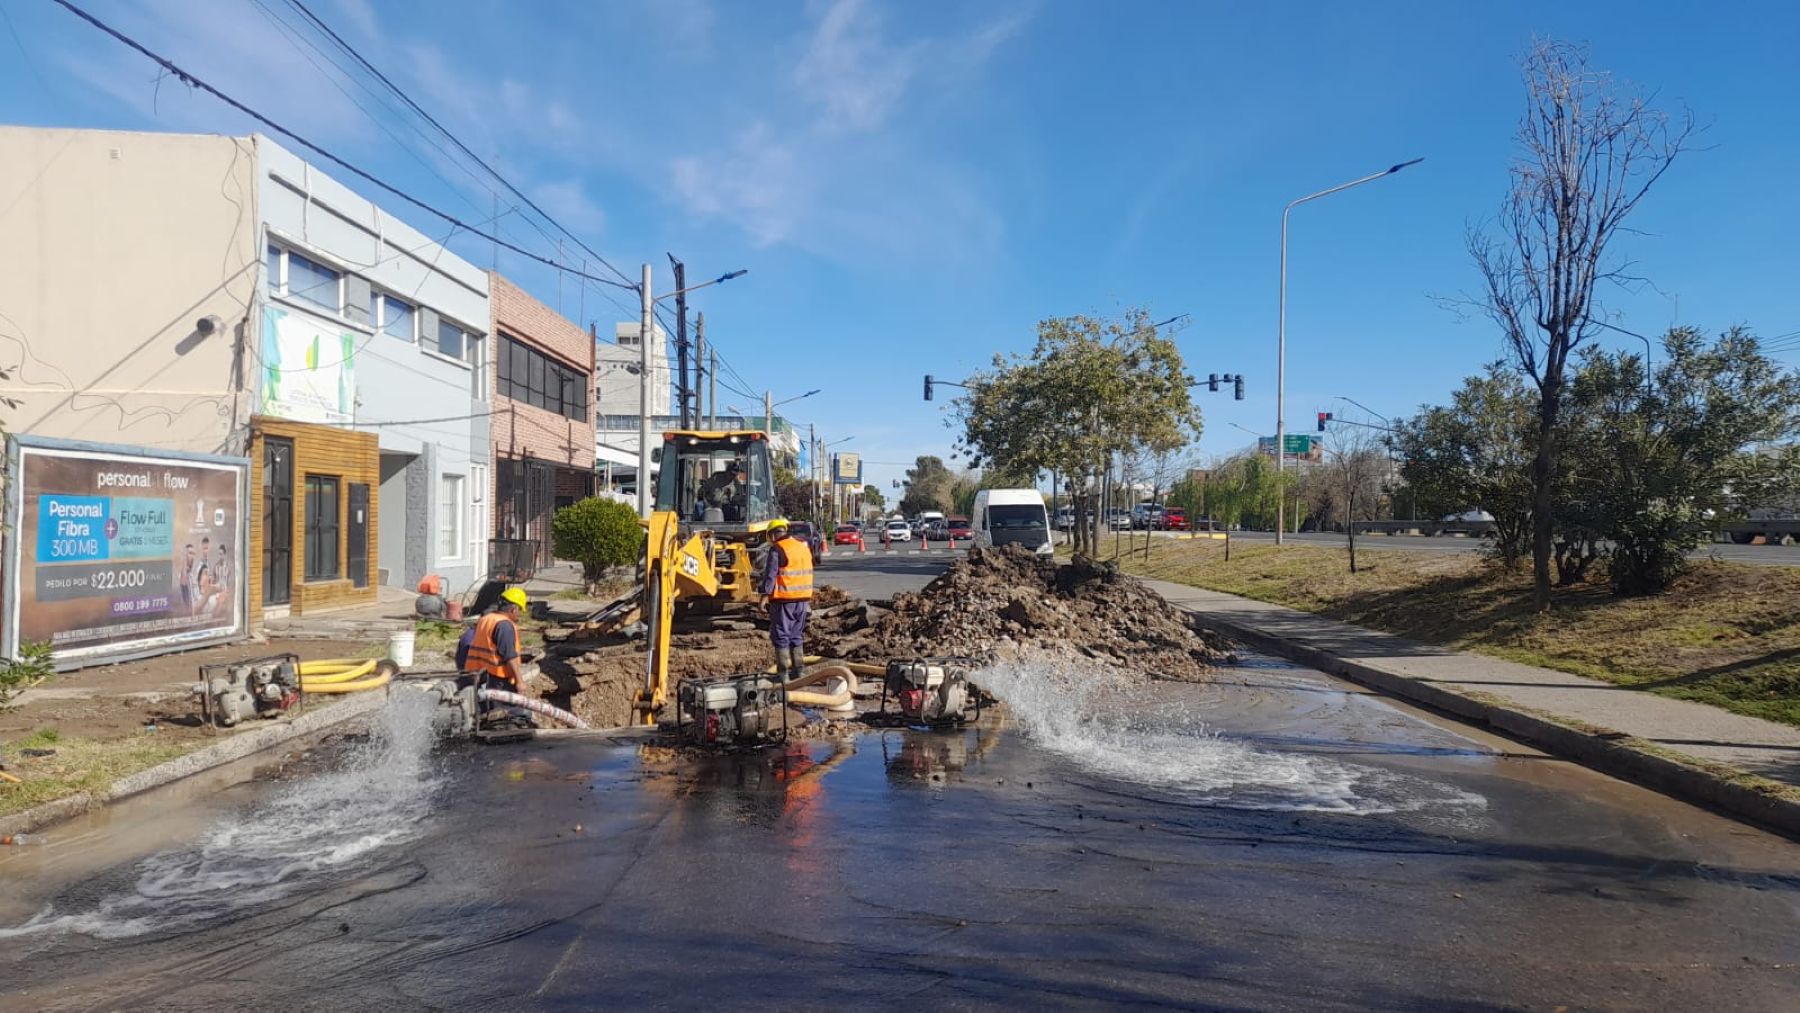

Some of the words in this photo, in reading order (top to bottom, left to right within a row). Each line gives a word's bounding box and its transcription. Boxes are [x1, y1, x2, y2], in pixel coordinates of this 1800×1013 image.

[97, 472, 151, 488] personal
[163, 473, 188, 488] flow
[49, 501, 103, 517] Personal
[120, 510, 146, 525] Flow
[148, 510, 166, 525] Full
[57, 521, 90, 536] Fibra
[51, 540, 77, 557] 300
[78, 539, 99, 556] MB
[683, 553, 699, 577] JCB
[73, 577, 88, 586] POR
[91, 569, 145, 589] $22.000
[113, 601, 135, 612] 0800
